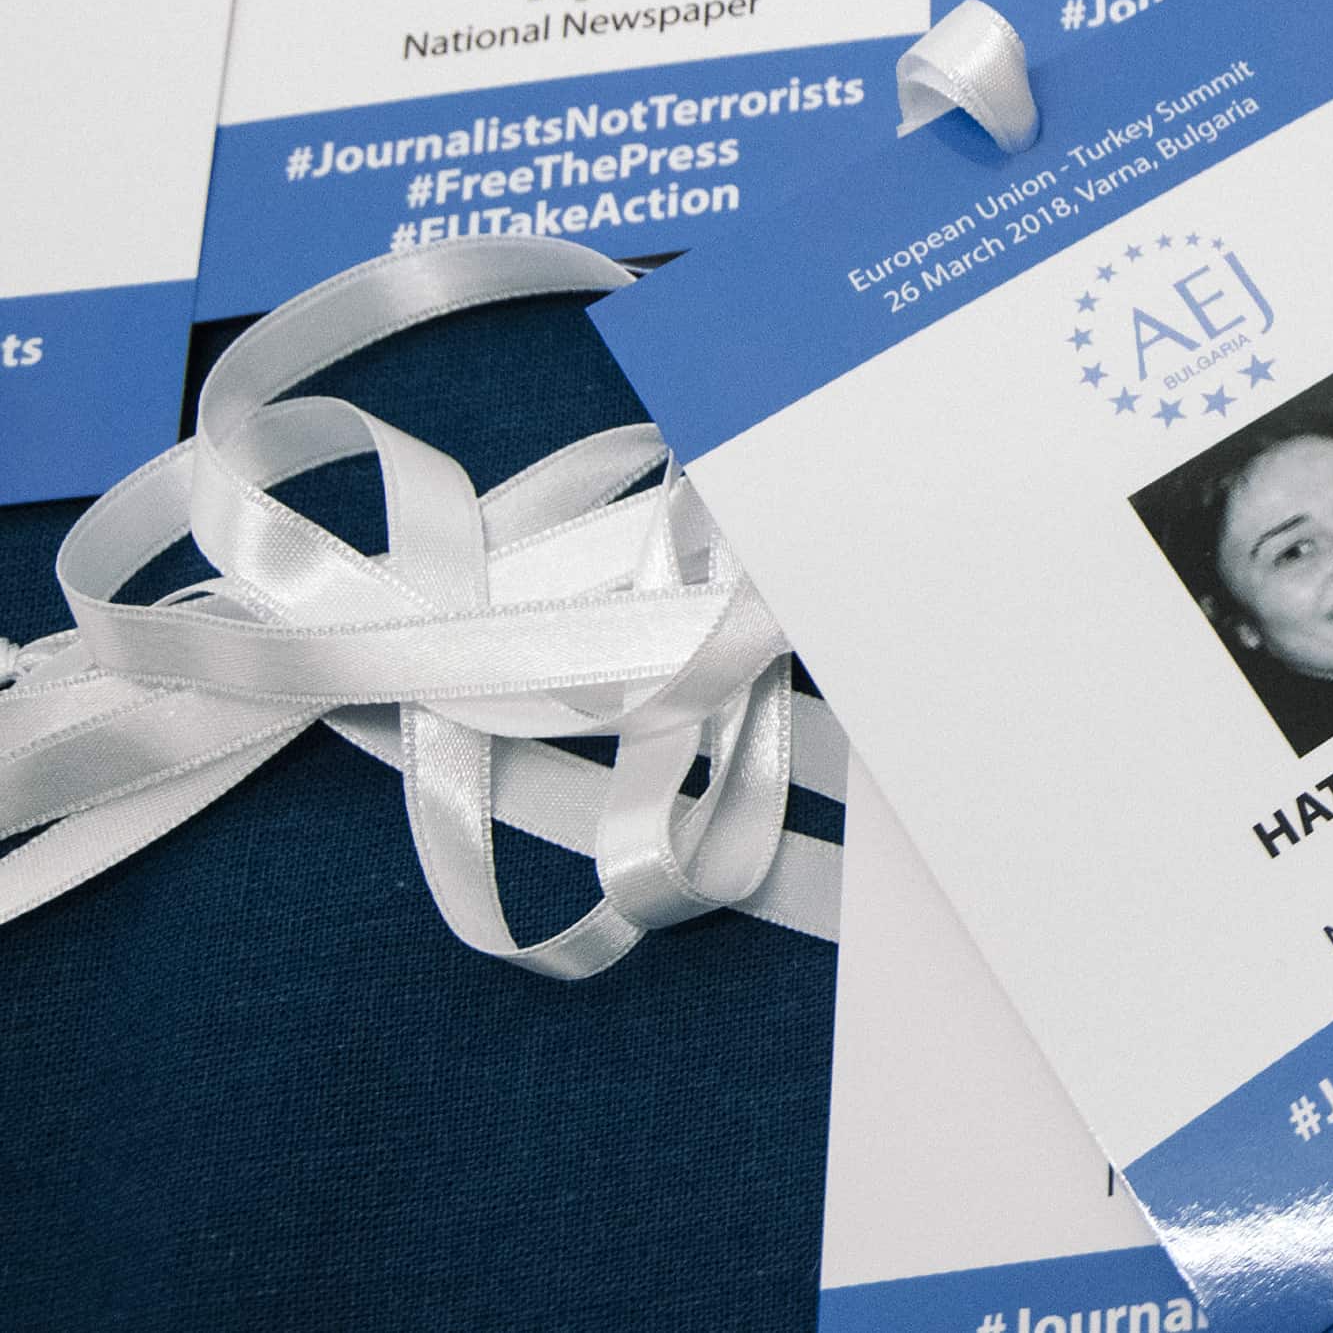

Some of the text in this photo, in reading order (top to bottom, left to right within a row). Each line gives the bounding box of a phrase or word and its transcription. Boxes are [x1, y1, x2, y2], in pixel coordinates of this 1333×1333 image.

[404, 14, 550, 59] National
[287, 75, 864, 181] #JournalistsNotTerrorists
[407, 136, 740, 209] #FreeThePress
[848, 212, 974, 292] European
[975, 171, 1057, 221] Union
[1067, 119, 1157, 167] Turkey
[1156, 59, 1255, 122] Summit
[884, 96, 1260, 313] 26 March 2018, Varna, Bulgaria
[1131, 250, 1275, 380] AEJ
[1163, 332, 1251, 391] BULGARIA
